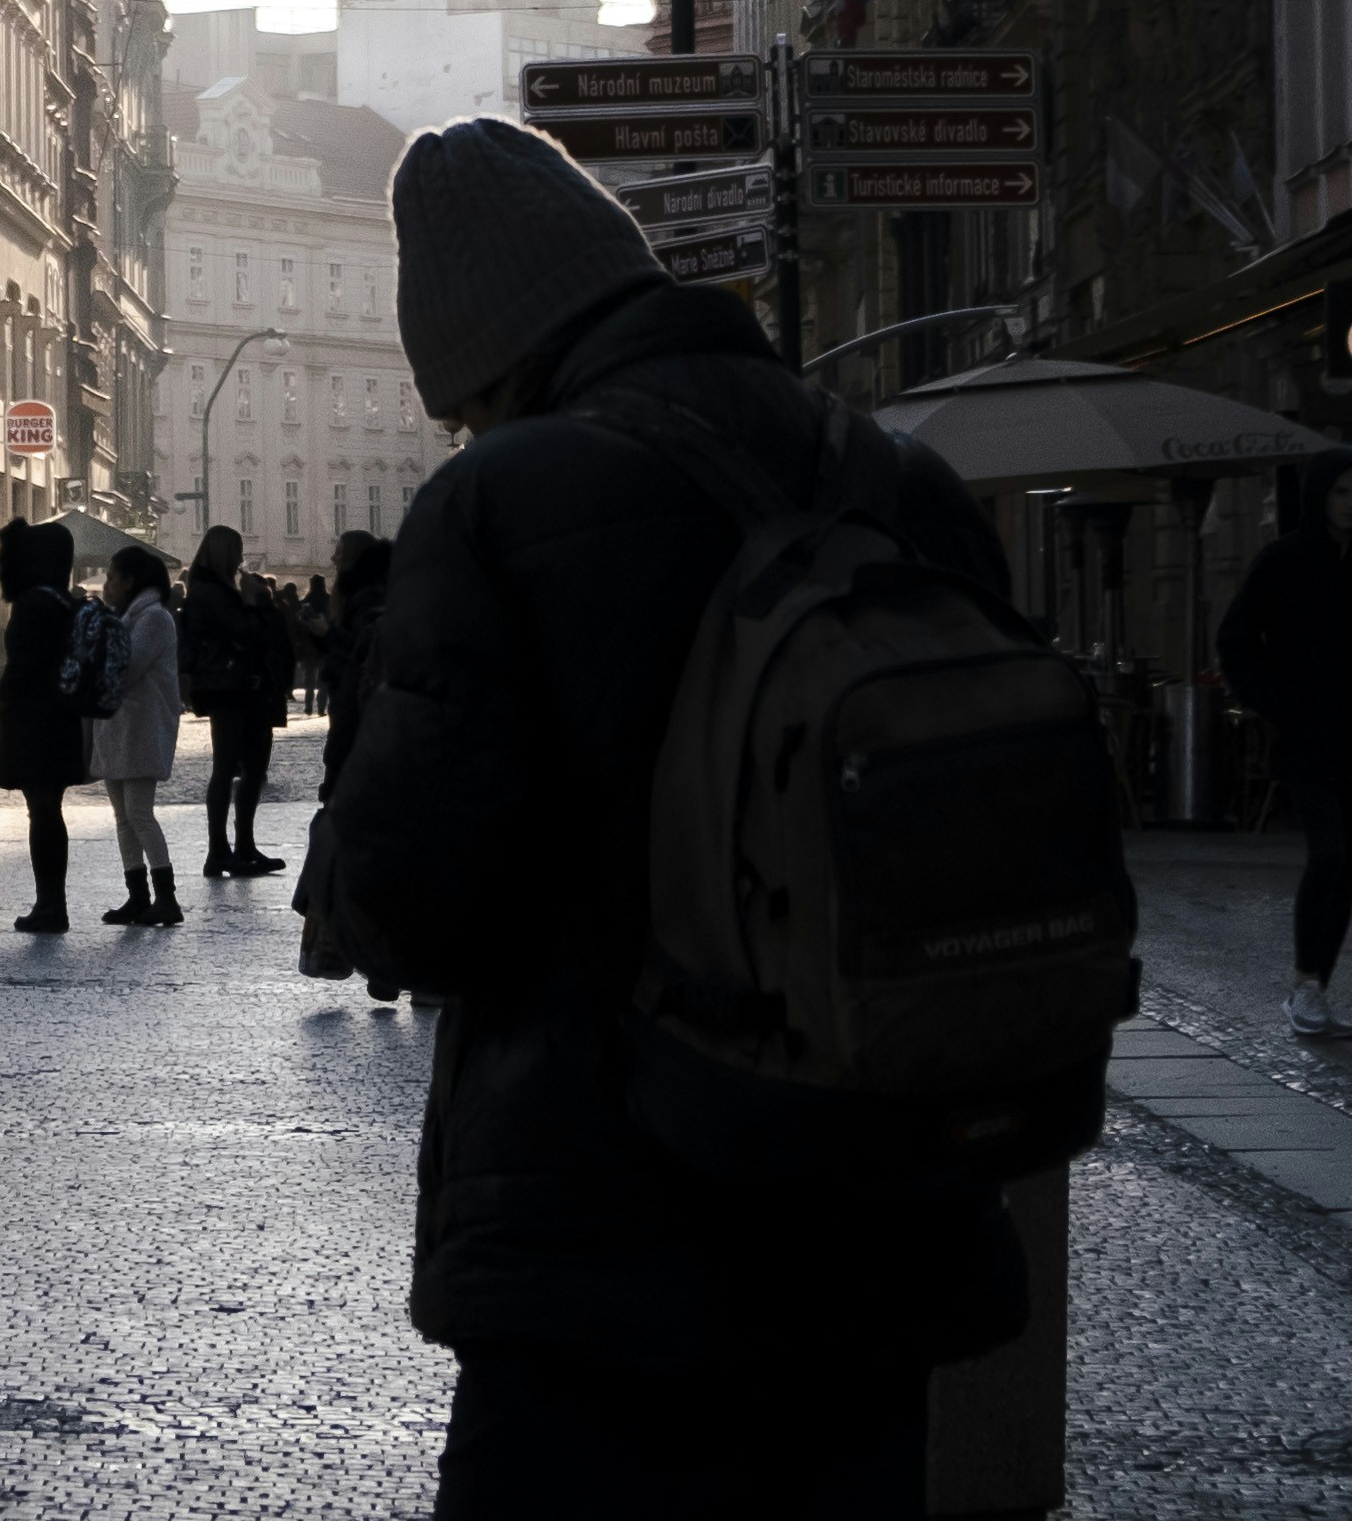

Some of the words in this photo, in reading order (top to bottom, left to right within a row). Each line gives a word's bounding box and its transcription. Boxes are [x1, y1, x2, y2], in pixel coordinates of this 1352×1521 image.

[578, 72, 641, 98] Národní
[648, 75, 716, 95] muzeum
[847, 64, 936, 88] Staroměstská
[940, 64, 988, 88] radnice
[614, 125, 666, 150] Hlavní
[673, 123, 719, 153] pošta
[848, 119, 926, 143] Stavovské
[933, 119, 988, 142] divadlo
[850, 173, 921, 196] Turistické
[925, 173, 1000, 196] informace
[663, 189, 703, 214] Národní
[707, 184, 744, 208] divadlo
[671, 252, 698, 275] Marie
[7, 418, 53, 429] BURGER
[7, 429, 53, 444] KING
[922, 921, 1044, 961] VOYAGER
[1047, 911, 1095, 940] BAG
